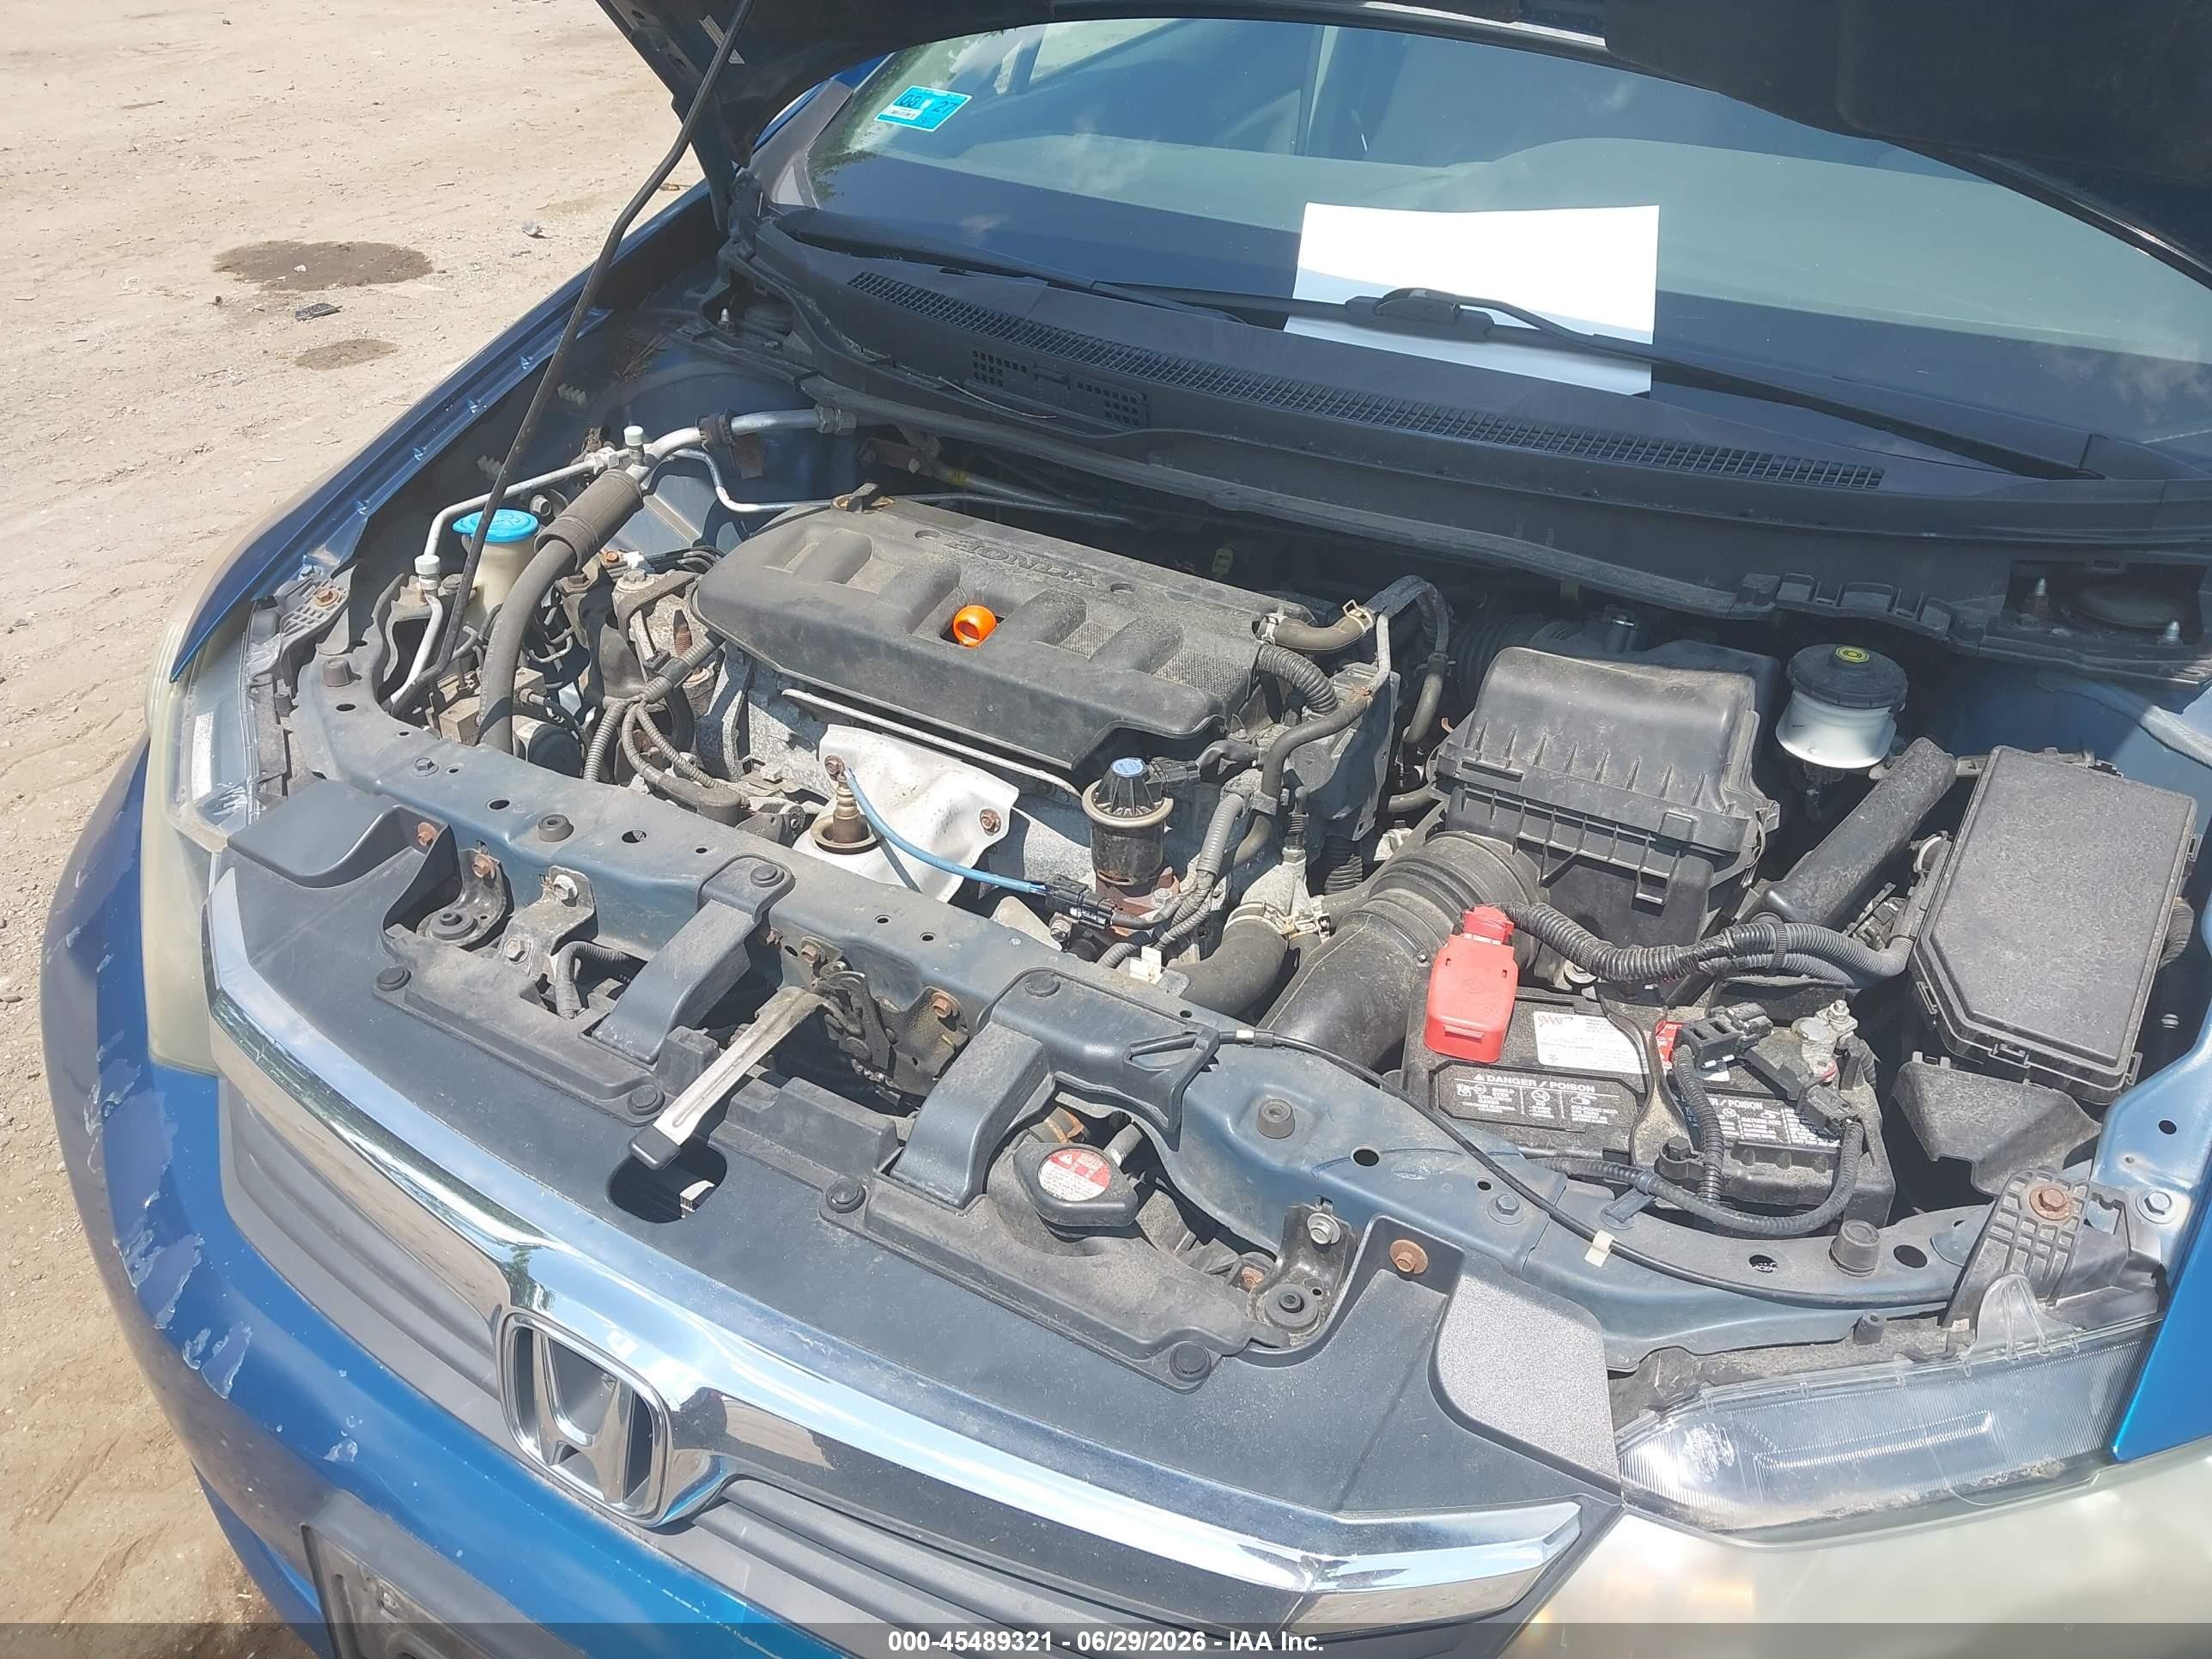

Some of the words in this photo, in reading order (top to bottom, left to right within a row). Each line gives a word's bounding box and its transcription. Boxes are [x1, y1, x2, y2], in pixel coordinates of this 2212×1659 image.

[944, 540, 1097, 587] HONDA
[1486, 1074, 1536, 1087] DANGER
[1549, 1081, 1595, 1093] POISON
[1728, 1099, 1764, 1110] POISON
